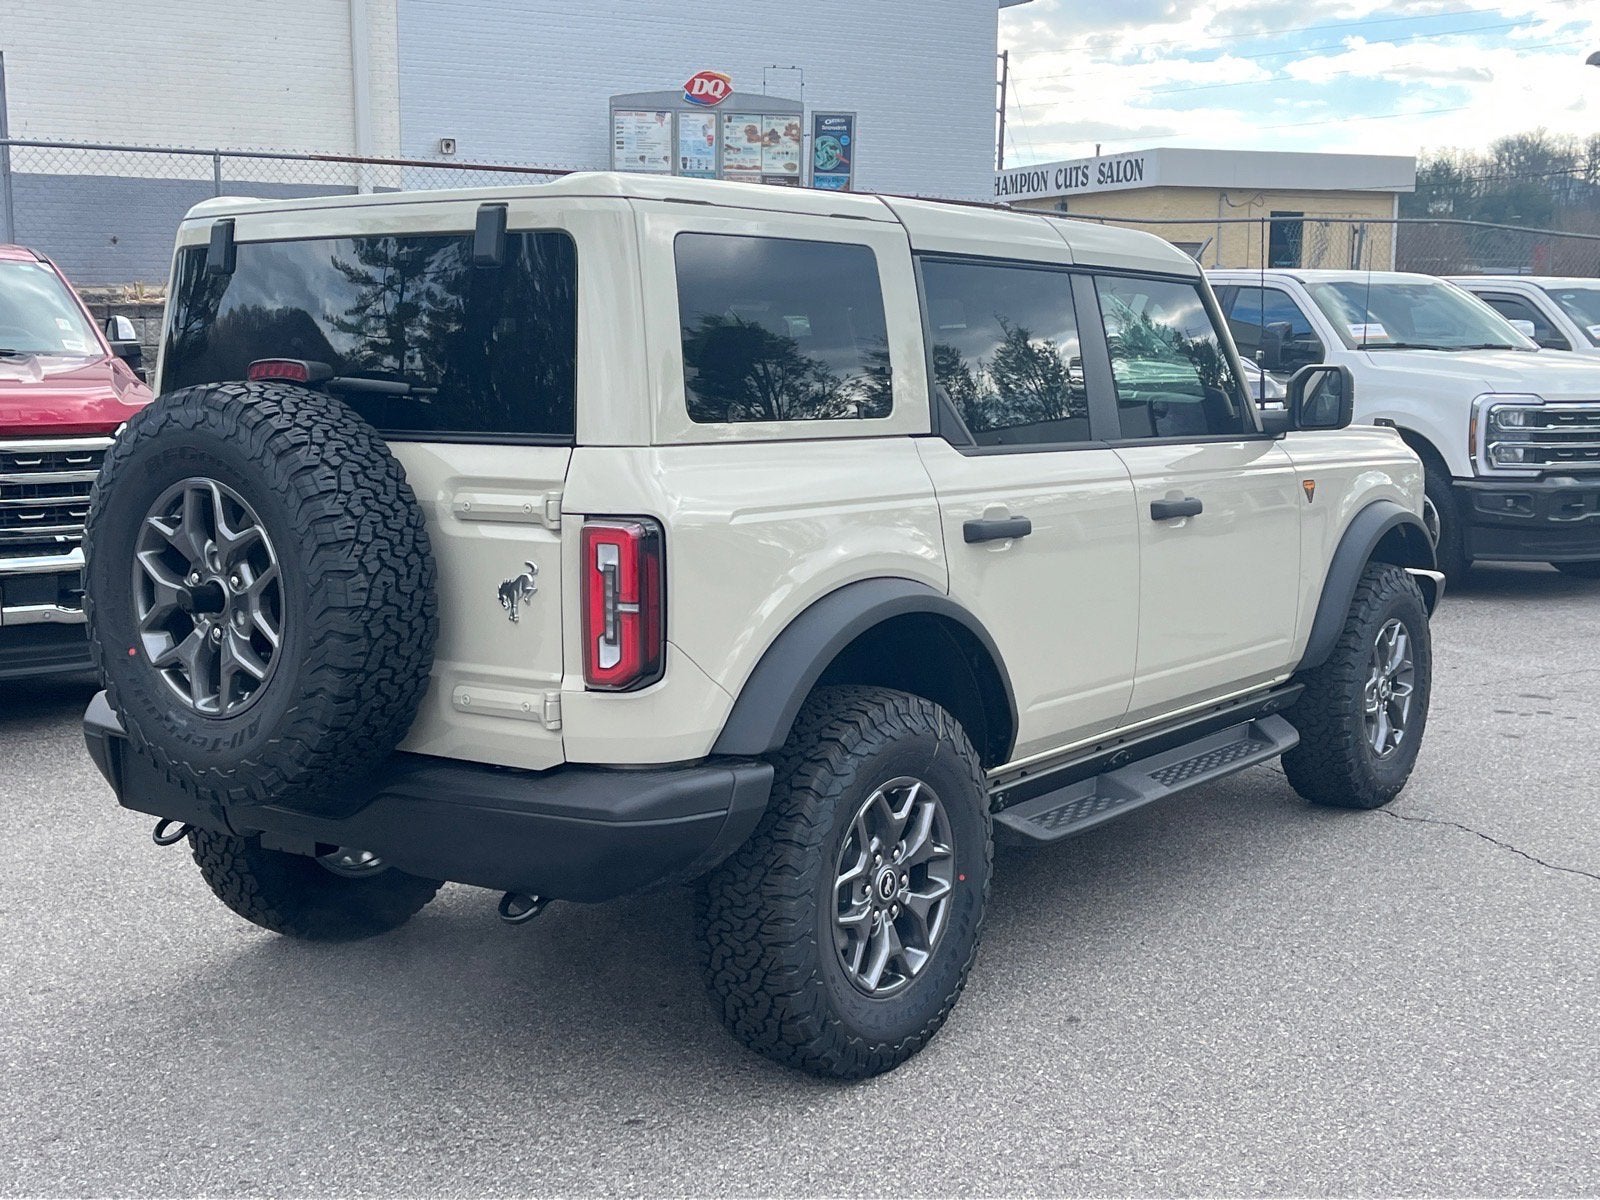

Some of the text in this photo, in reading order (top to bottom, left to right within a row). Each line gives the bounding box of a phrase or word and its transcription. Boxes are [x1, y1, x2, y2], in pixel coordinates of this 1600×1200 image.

[691, 78, 725, 99] DQ
[994, 158, 1144, 196] HAMPION CUTS SALON
